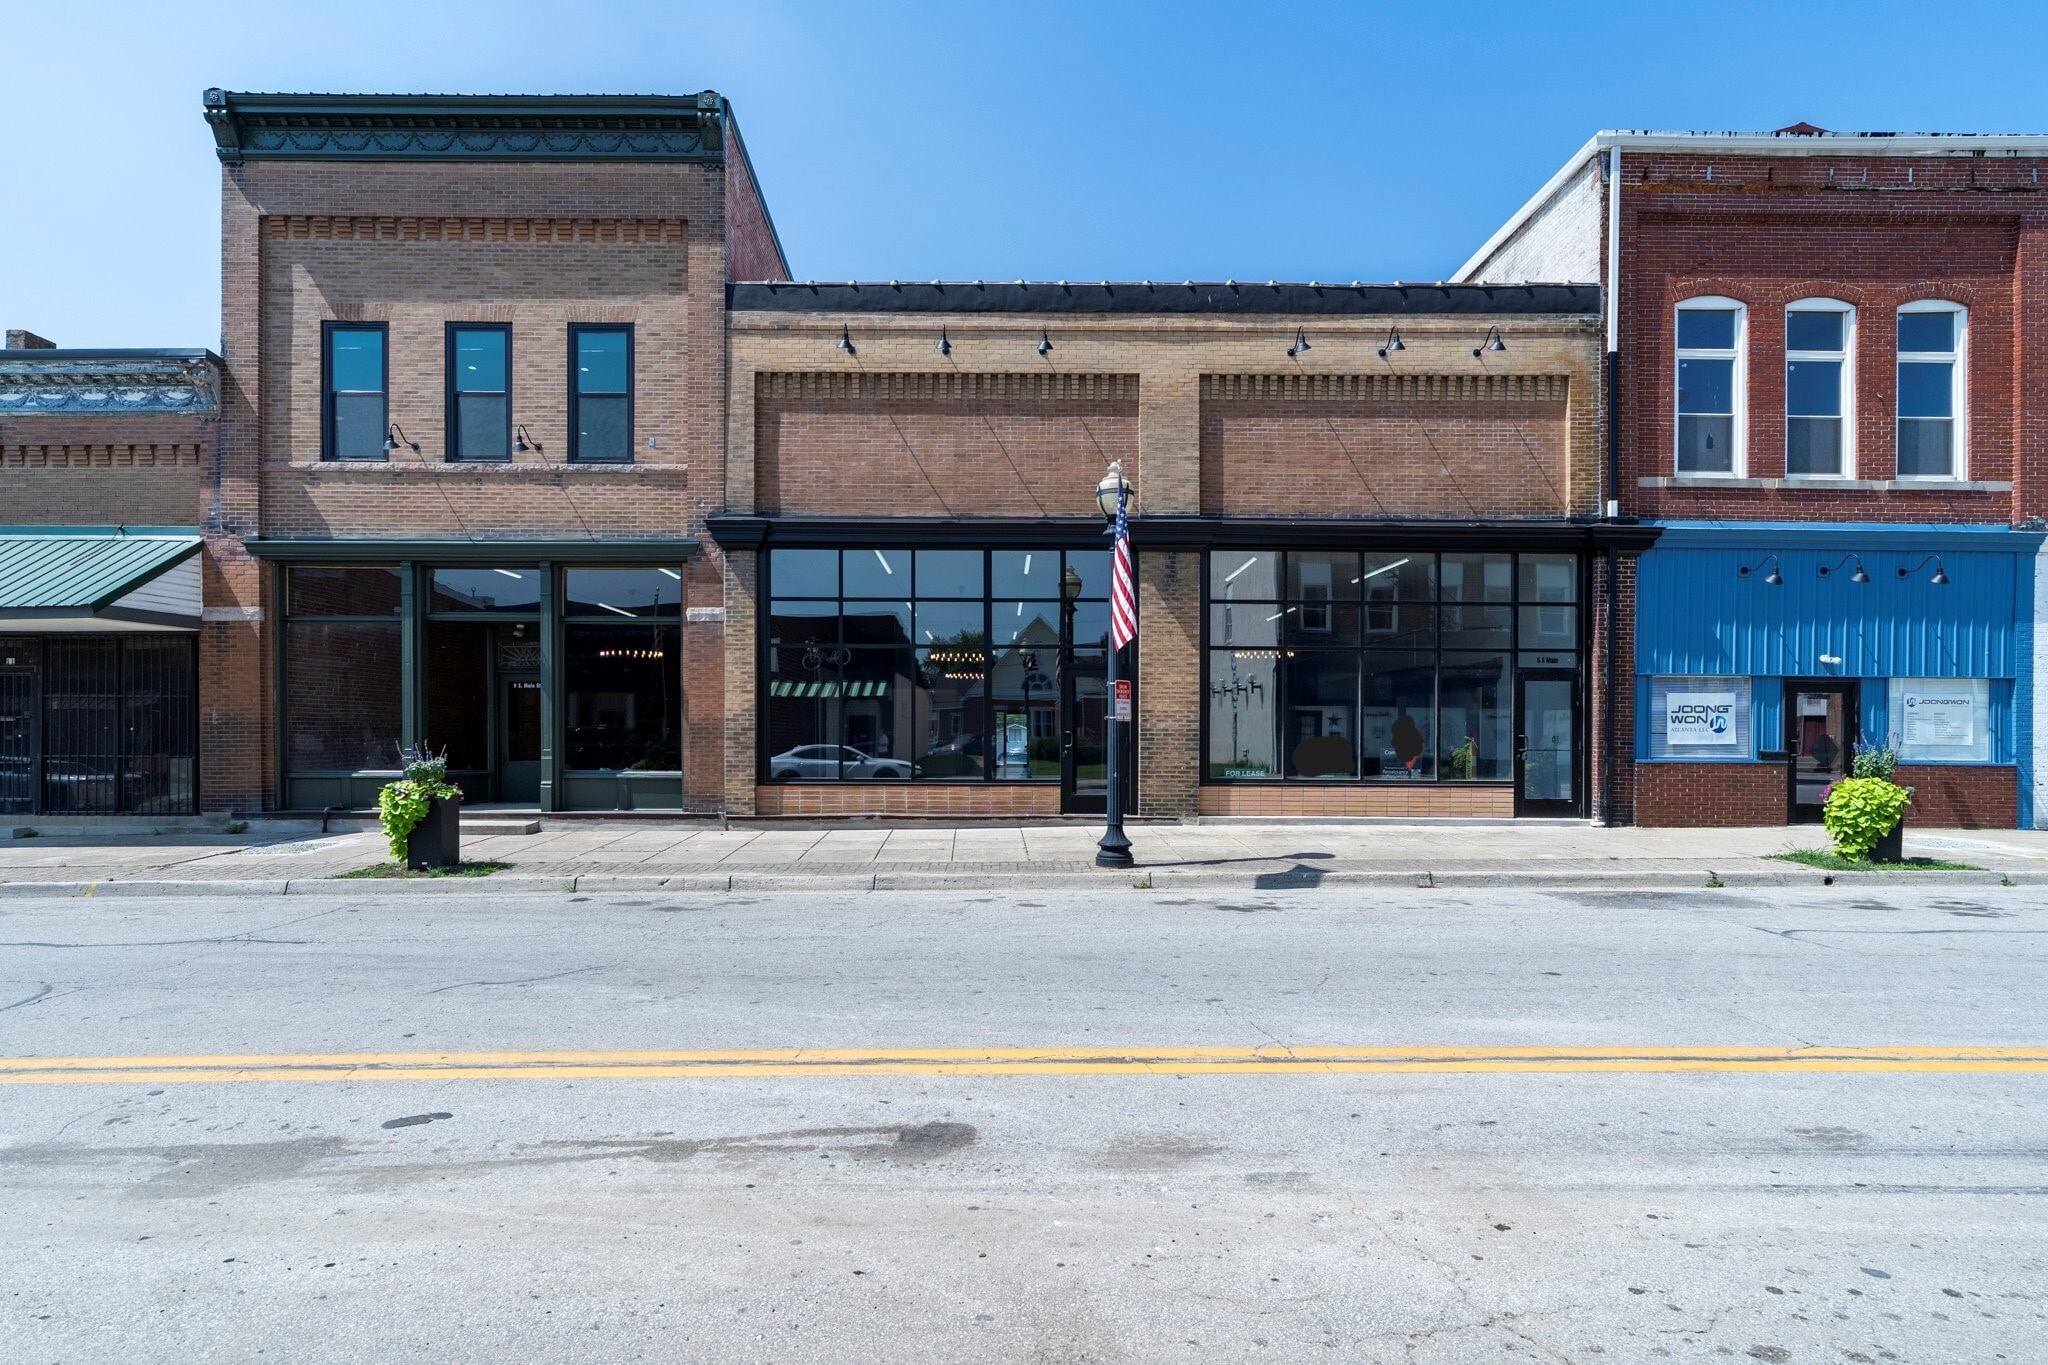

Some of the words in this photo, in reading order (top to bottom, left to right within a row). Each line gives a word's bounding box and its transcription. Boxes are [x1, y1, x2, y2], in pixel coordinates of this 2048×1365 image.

[1546, 656, 1559, 664] Main
[1671, 704, 1733, 714] JOONG
[1670, 715, 1709, 724] WON
